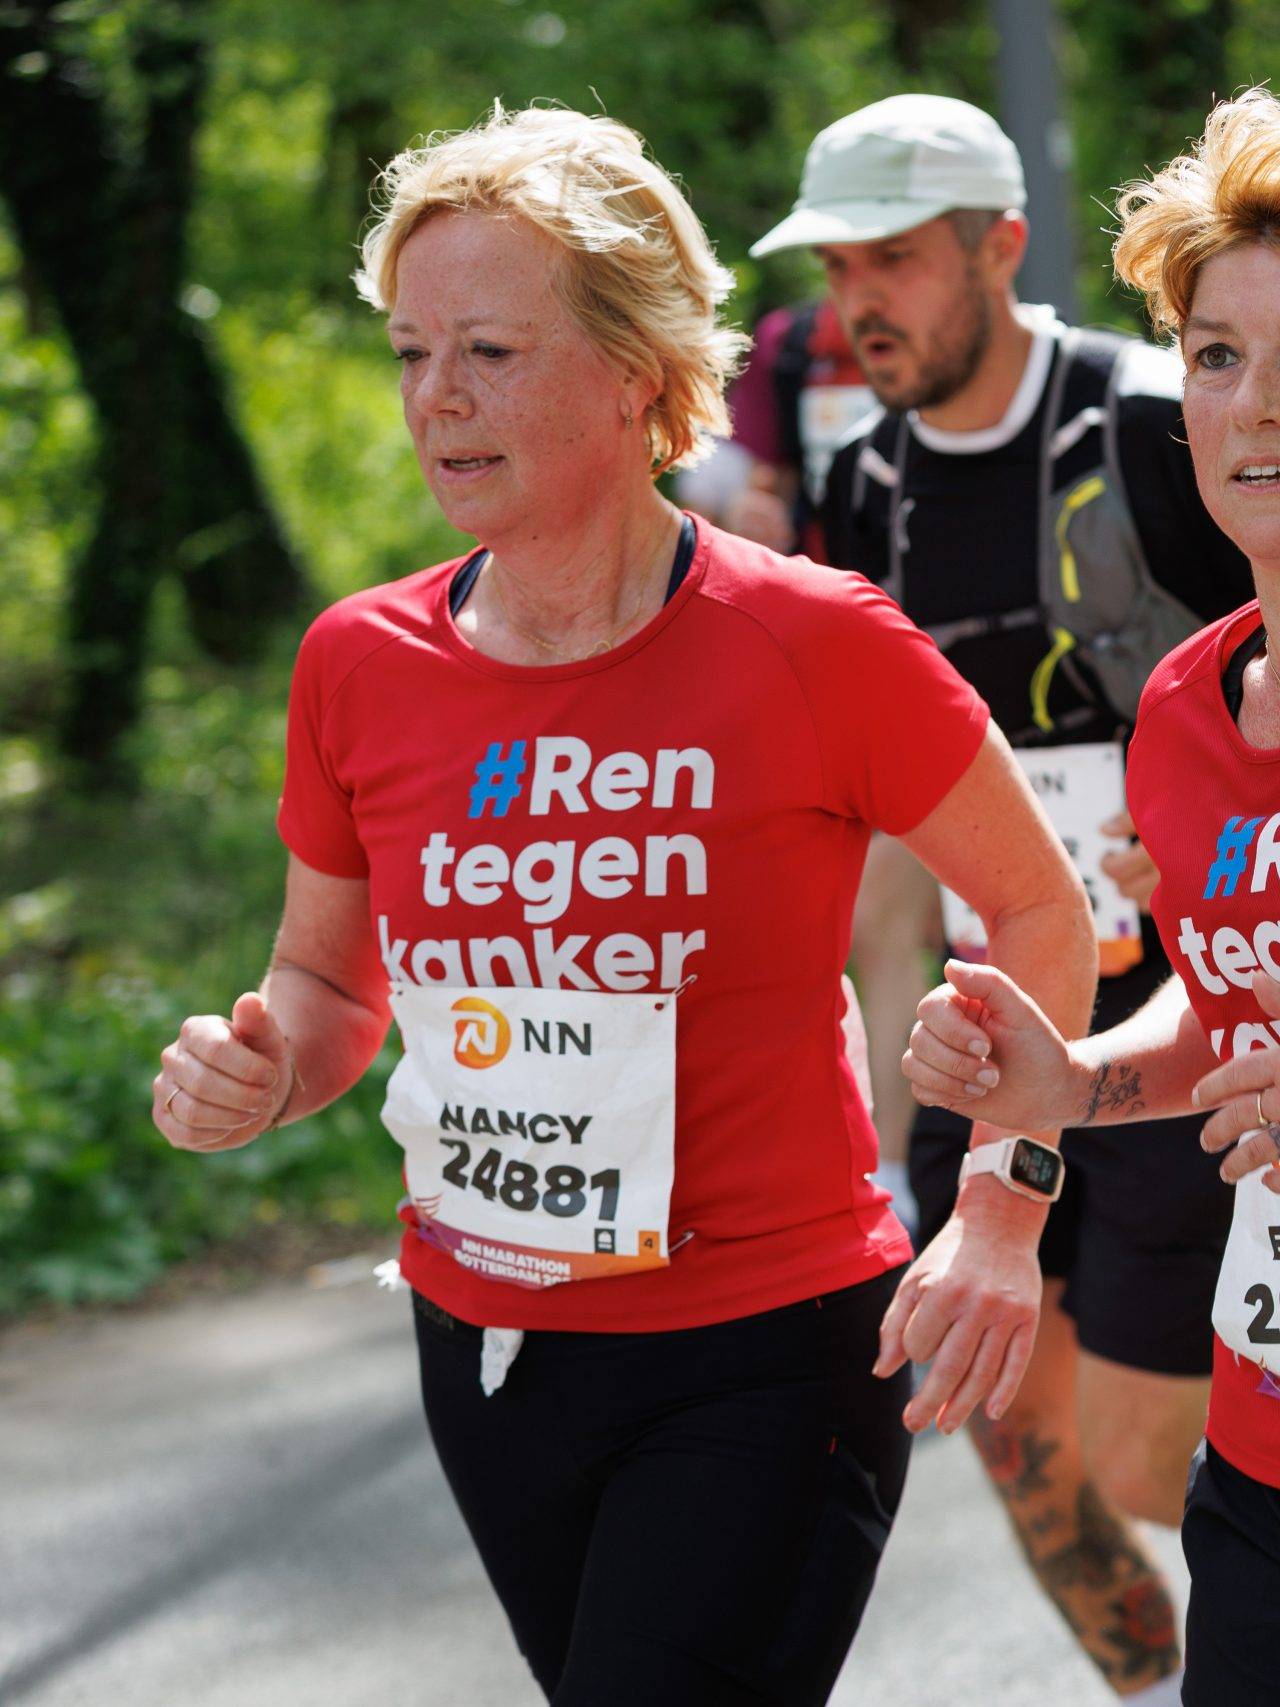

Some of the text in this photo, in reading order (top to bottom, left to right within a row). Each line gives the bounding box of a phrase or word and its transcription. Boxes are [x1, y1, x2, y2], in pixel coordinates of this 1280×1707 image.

[468, 736, 715, 819] #Ren
[420, 832, 707, 924] tegen
[378, 914, 706, 991] kanker
[521, 1018, 592, 1056] NN
[440, 1102, 593, 1145] NANCY
[439, 1138, 620, 1221] 24881
[483, 1245, 571, 1276] MARATHON
[643, 1237, 654, 1249] 4
[454, 1249, 541, 1287] ROTTERDAM
